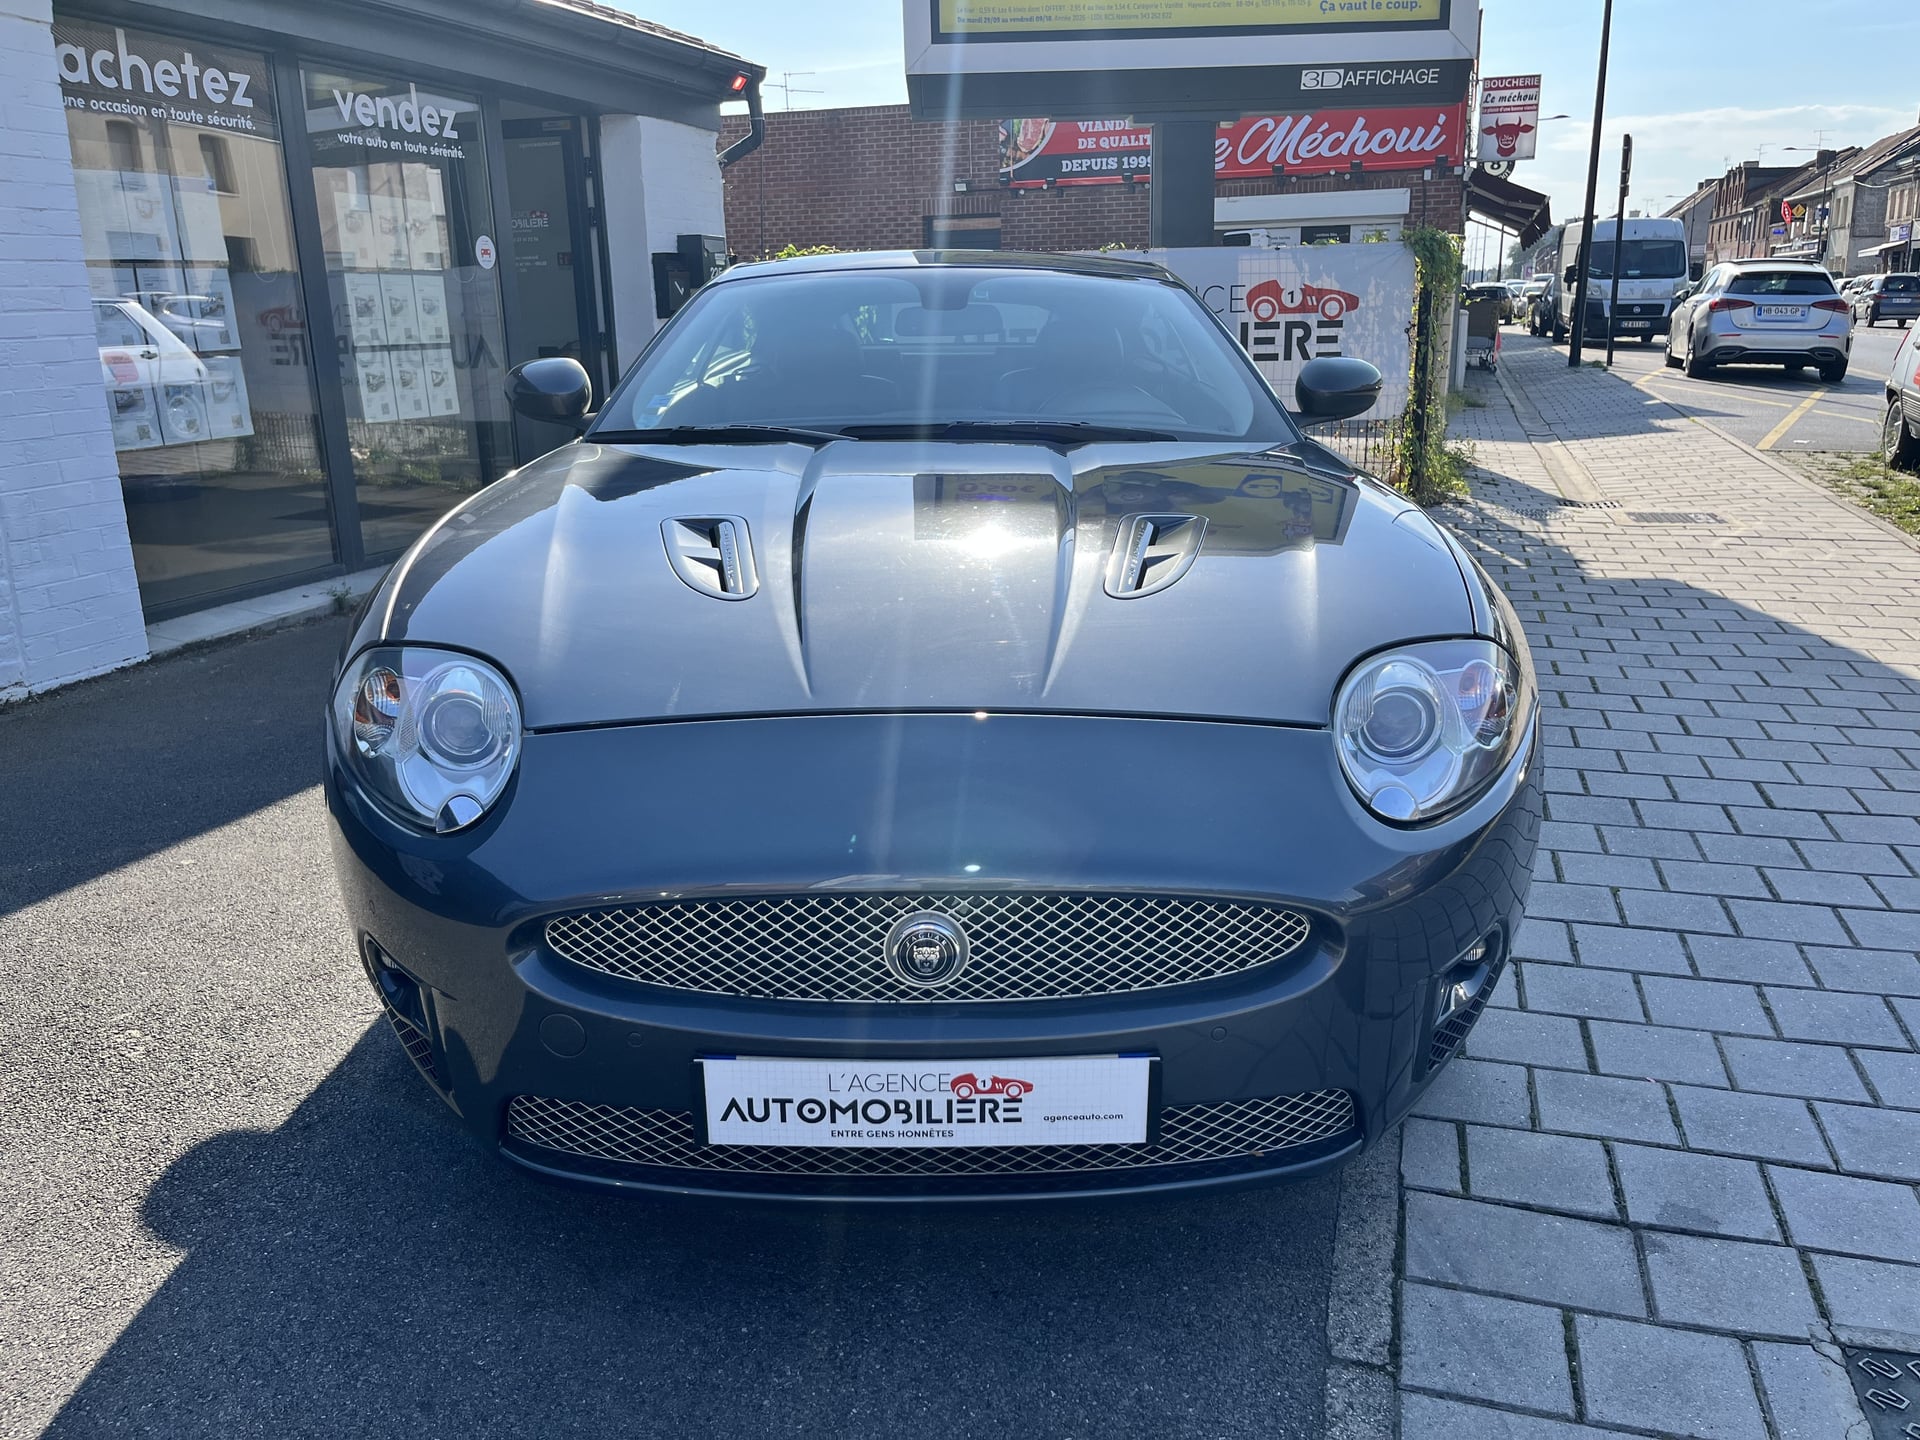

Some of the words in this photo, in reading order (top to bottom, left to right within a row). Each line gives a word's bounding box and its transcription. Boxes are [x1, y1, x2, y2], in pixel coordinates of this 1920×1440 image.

[1320, 0, 1335, 14] Ça
[1340, 1, 1367, 11] vaut
[1371, 0, 1382, 10] le
[1386, 0, 1421, 12] coup.
[55, 28, 254, 108] achetez
[1301, 70, 1344, 89] 3D
[1344, 69, 1440, 86] AFFICHAGE
[1484, 77, 1539, 89] BOUCHERIE
[1483, 92, 1496, 104] Le
[1498, 91, 1538, 103] méchoui
[90, 99, 146, 116] occasion
[151, 107, 166, 119] en
[170, 107, 204, 124] toute
[208, 111, 256, 130] sécurité.
[332, 82, 458, 139] vendez
[1077, 119, 1133, 133] VIAND
[338, 132, 363, 146] votre
[366, 136, 388, 148] auto
[390, 140, 402, 150] en
[404, 141, 428, 154] toute
[430, 142, 465, 159] sérénité.
[1078, 138, 1096, 150] DE
[1238, 114, 1447, 165] Méchoui
[1062, 157, 1118, 172] DEPUIS
[828, 1073, 950, 1092] L'AGENCE
[1043, 1112, 1124, 1123] agenceauto.com
[831, 1130, 864, 1138] ENTRE
[866, 1130, 895, 1138] GENS
[898, 1127, 954, 1138] HONNÊTES
